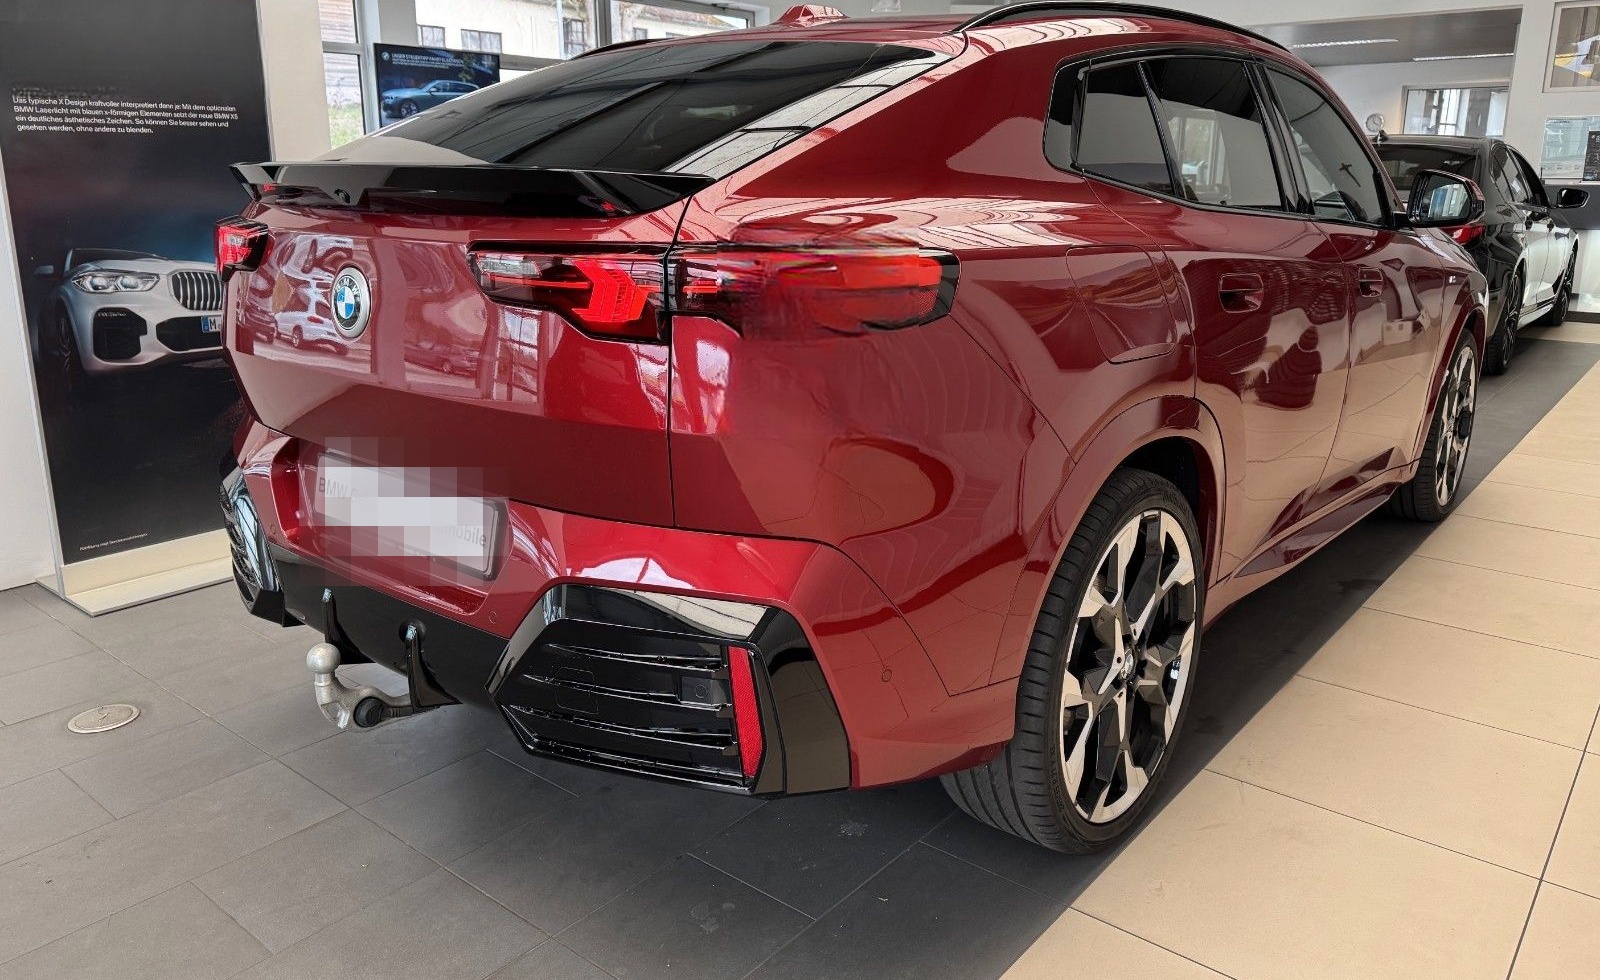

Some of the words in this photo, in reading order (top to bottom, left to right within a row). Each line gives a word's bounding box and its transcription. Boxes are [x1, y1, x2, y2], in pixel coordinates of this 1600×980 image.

[28, 96, 57, 106] typische
[64, 98, 88, 107] Design
[120, 101, 157, 109] interpretiert
[105, 109, 139, 117] x-förmigen
[140, 110, 173, 118] Elementen
[28, 115, 63, 123] deutliches
